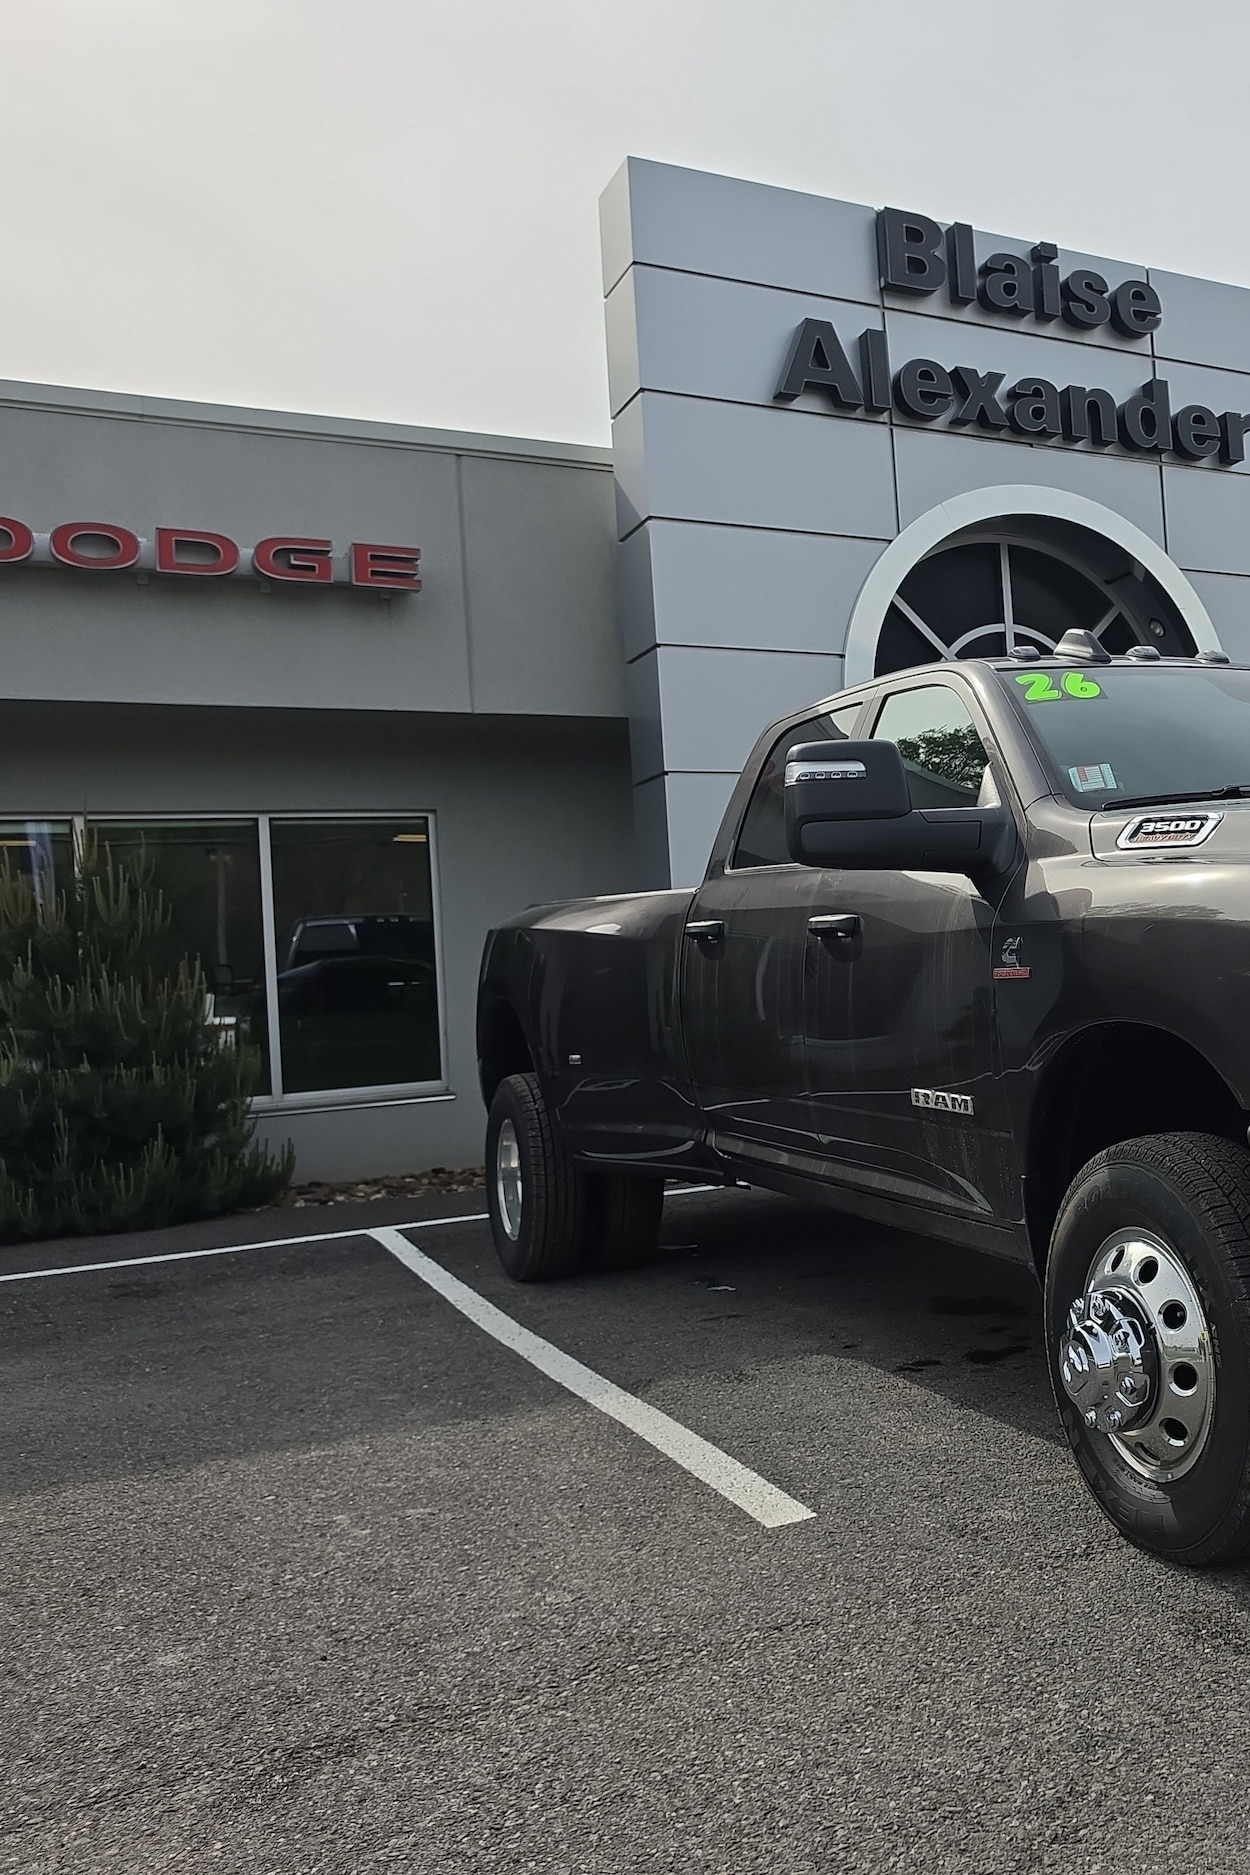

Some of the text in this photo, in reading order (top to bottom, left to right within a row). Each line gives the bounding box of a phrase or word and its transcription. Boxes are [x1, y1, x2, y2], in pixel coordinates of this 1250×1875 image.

[877, 206, 1162, 339] Blaise
[1015, 671, 1101, 702] 26
[1140, 820, 1201, 833] 3500
[911, 1088, 974, 1115] RAM
